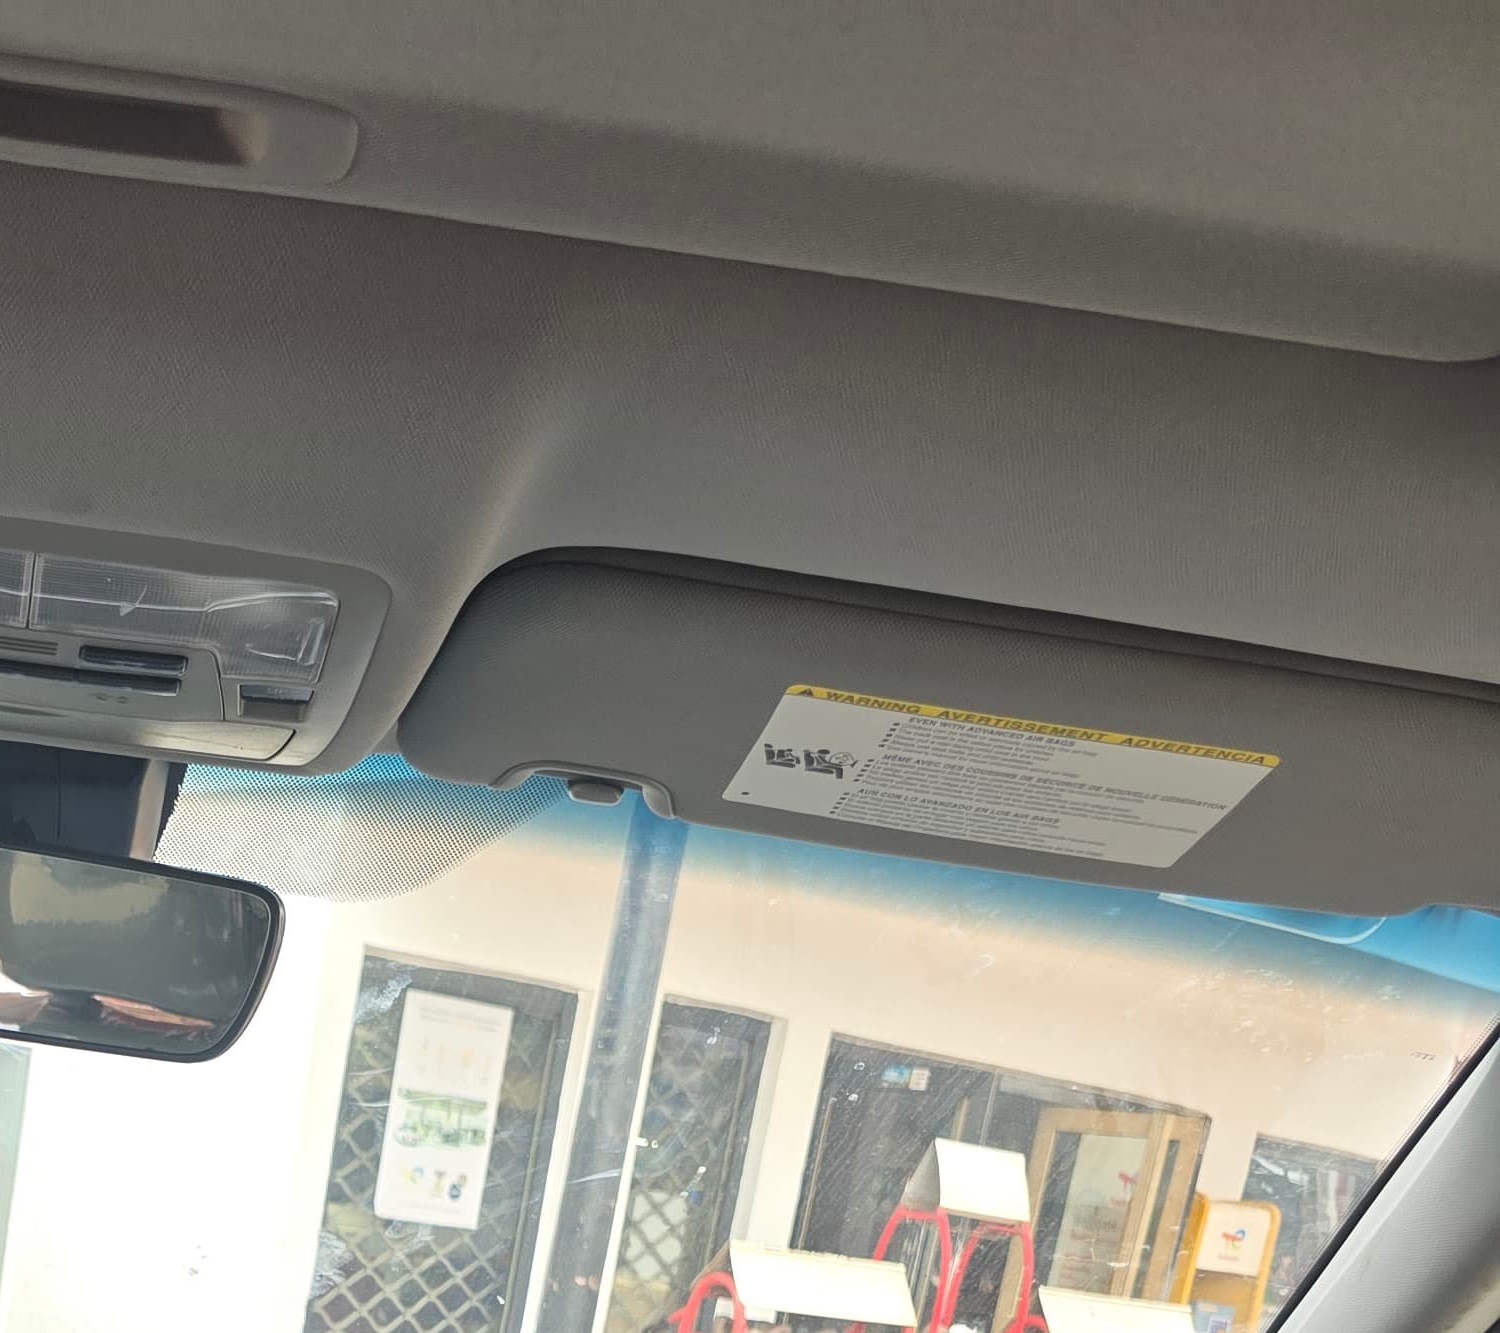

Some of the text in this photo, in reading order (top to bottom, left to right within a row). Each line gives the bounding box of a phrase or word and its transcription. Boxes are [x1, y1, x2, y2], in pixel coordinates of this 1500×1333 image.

[825, 690, 922, 714] WARNING
[937, 710, 1108, 741] AVERTISSEMENT
[1120, 737, 1266, 765] ADVERTENCIA
[908, 716, 937, 727] EVEN
[938, 720, 966, 731] WITH
[966, 725, 1025, 740] ADVANCED
